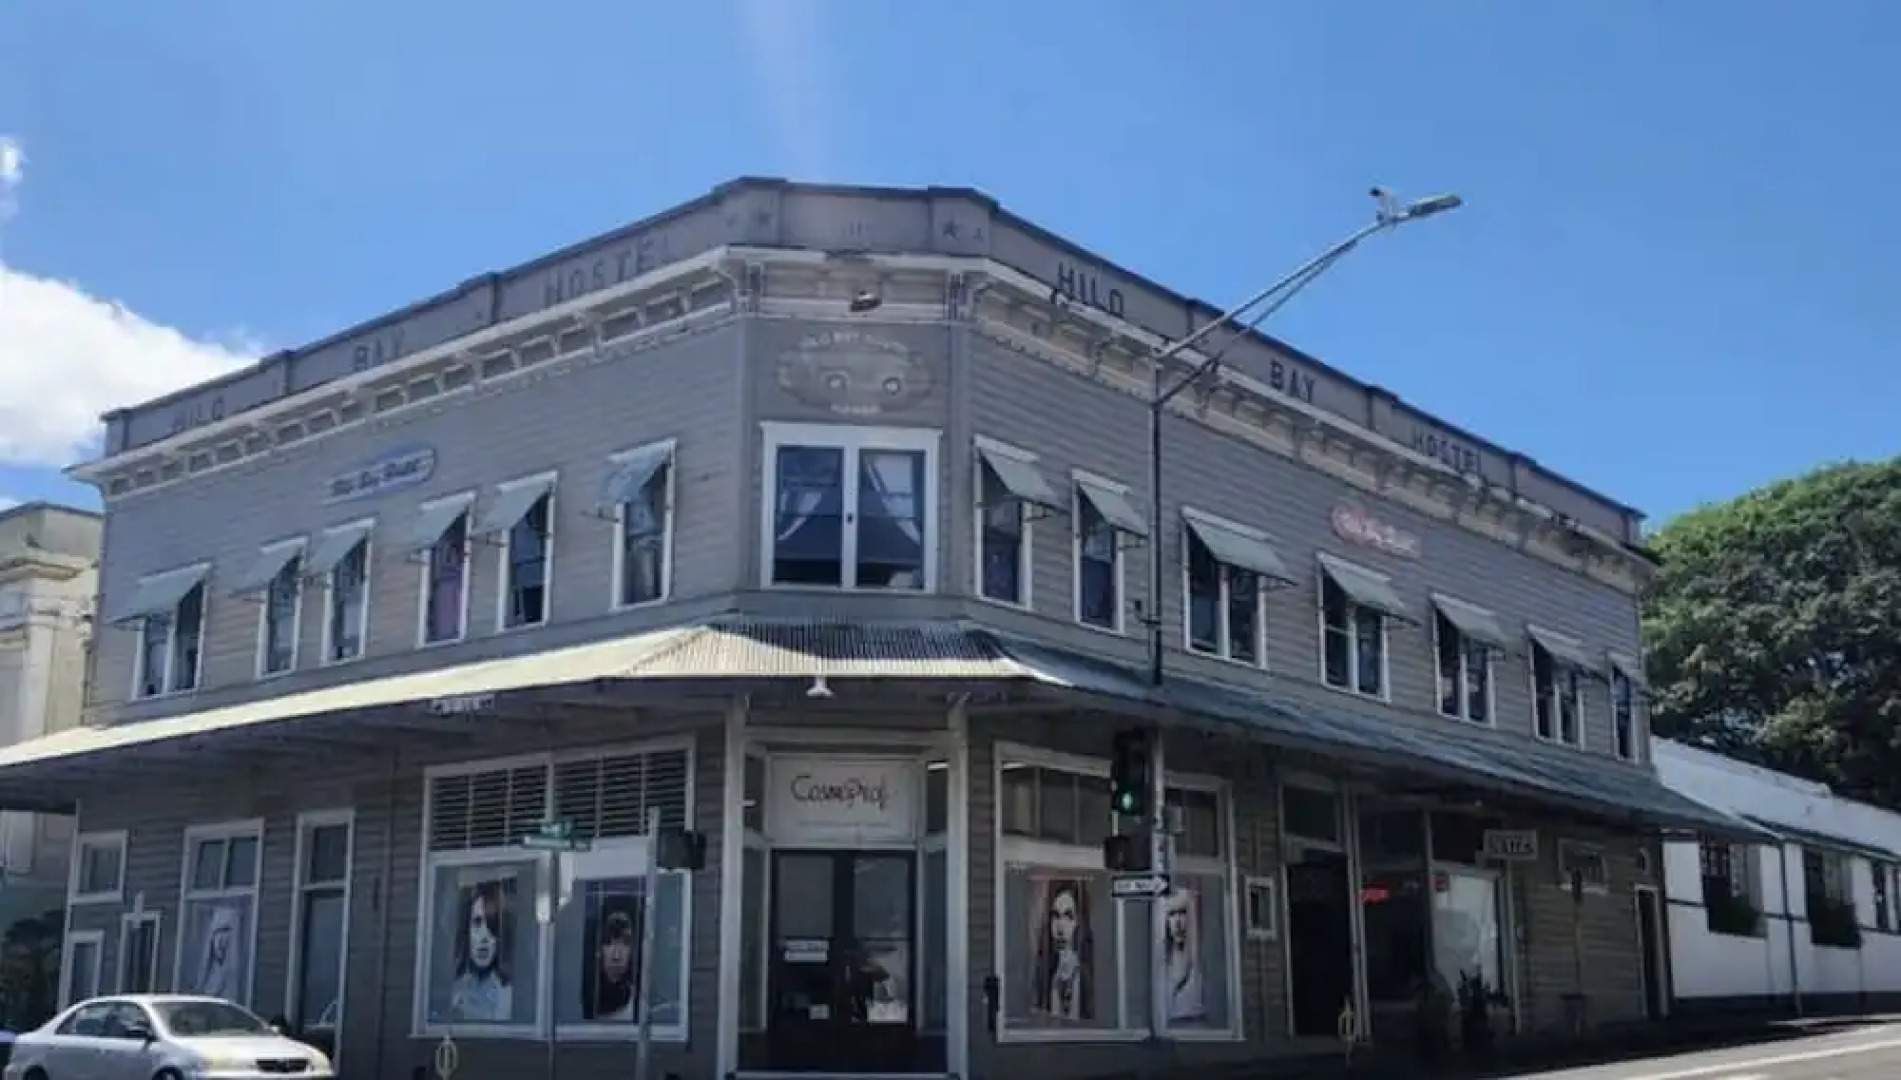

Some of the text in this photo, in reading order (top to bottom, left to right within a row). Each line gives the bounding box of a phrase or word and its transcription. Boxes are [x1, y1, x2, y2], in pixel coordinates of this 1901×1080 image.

[353, 327, 404, 371] BAY
[545, 233, 671, 307] HOSTEL
[1058, 261, 1482, 472] HILO BAY HOSTEL
